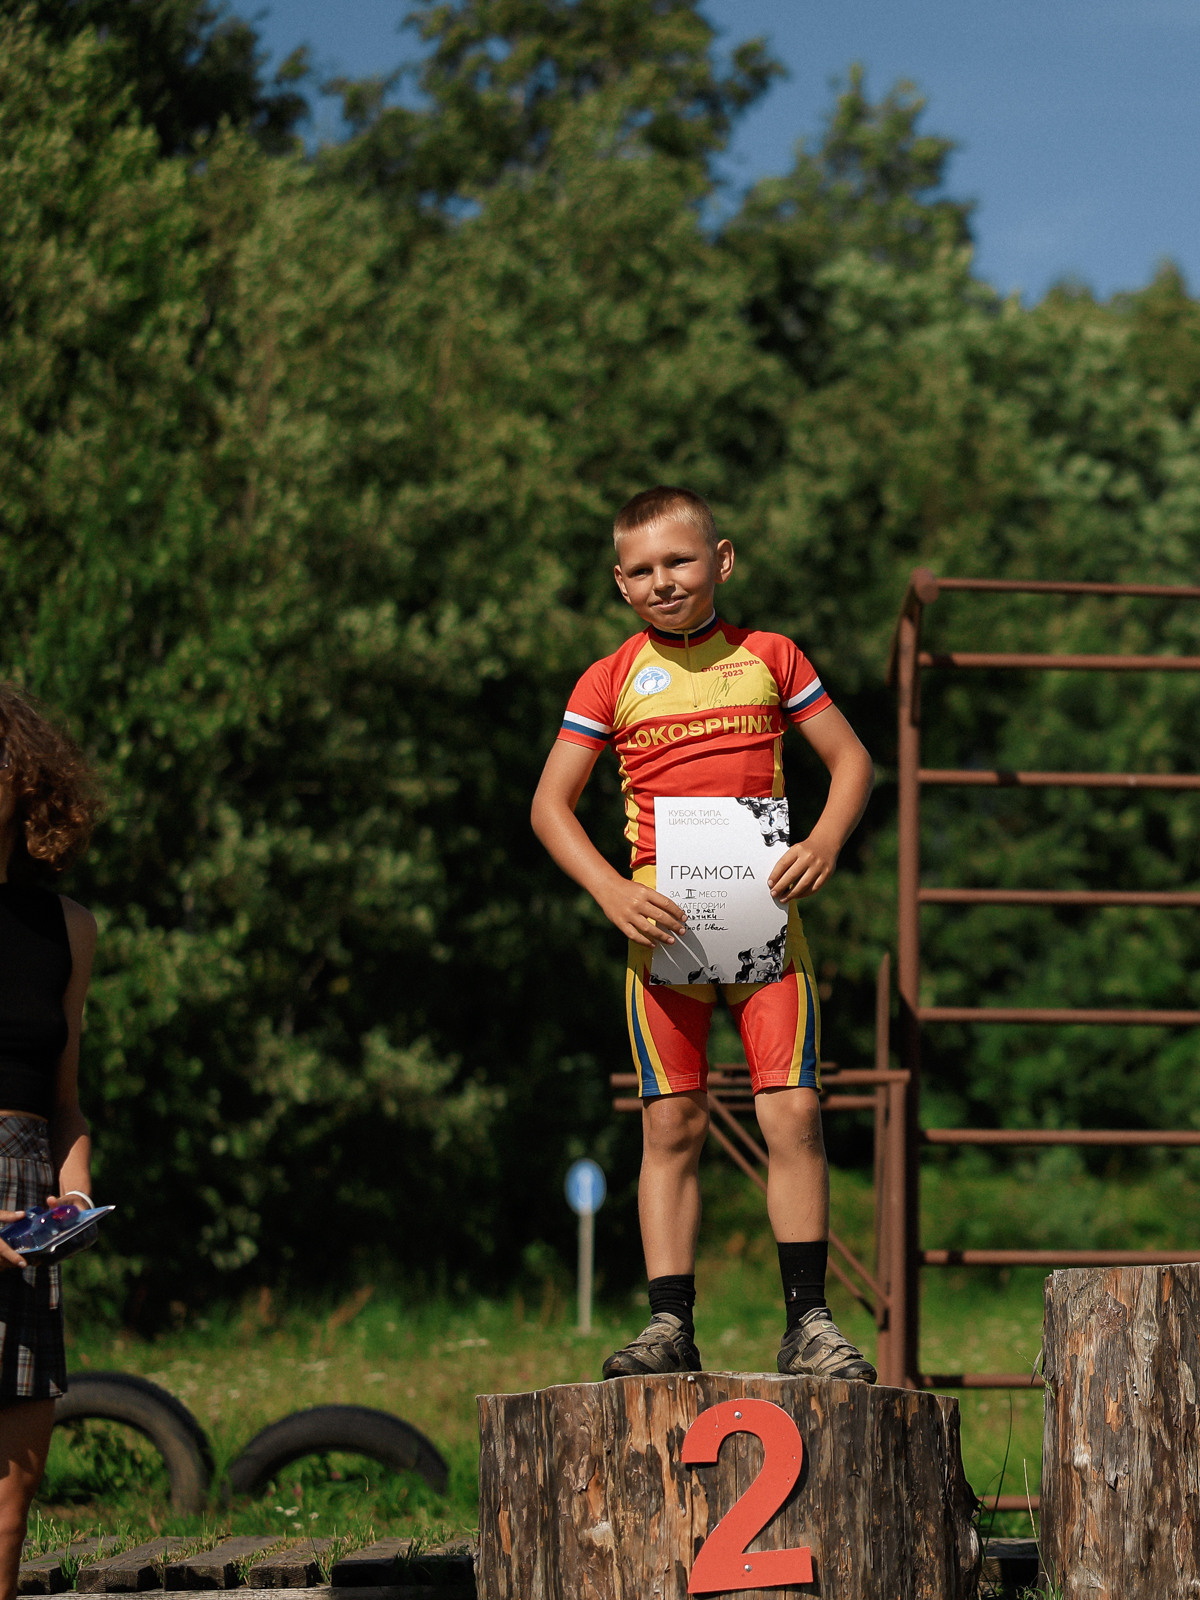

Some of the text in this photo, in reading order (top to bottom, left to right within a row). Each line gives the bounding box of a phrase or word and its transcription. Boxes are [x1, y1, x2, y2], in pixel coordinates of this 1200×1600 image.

[722, 669, 744, 678] 2023
[626, 714, 773, 749] LOKOSPHINX
[668, 818, 730, 826] ЦИКЛОКРОСС
[670, 865, 755, 880] ГРАМОТА
[670, 890, 681, 898] ЗА
[698, 890, 728, 898] МЕСТО
[681, 1398, 814, 1594] 2
